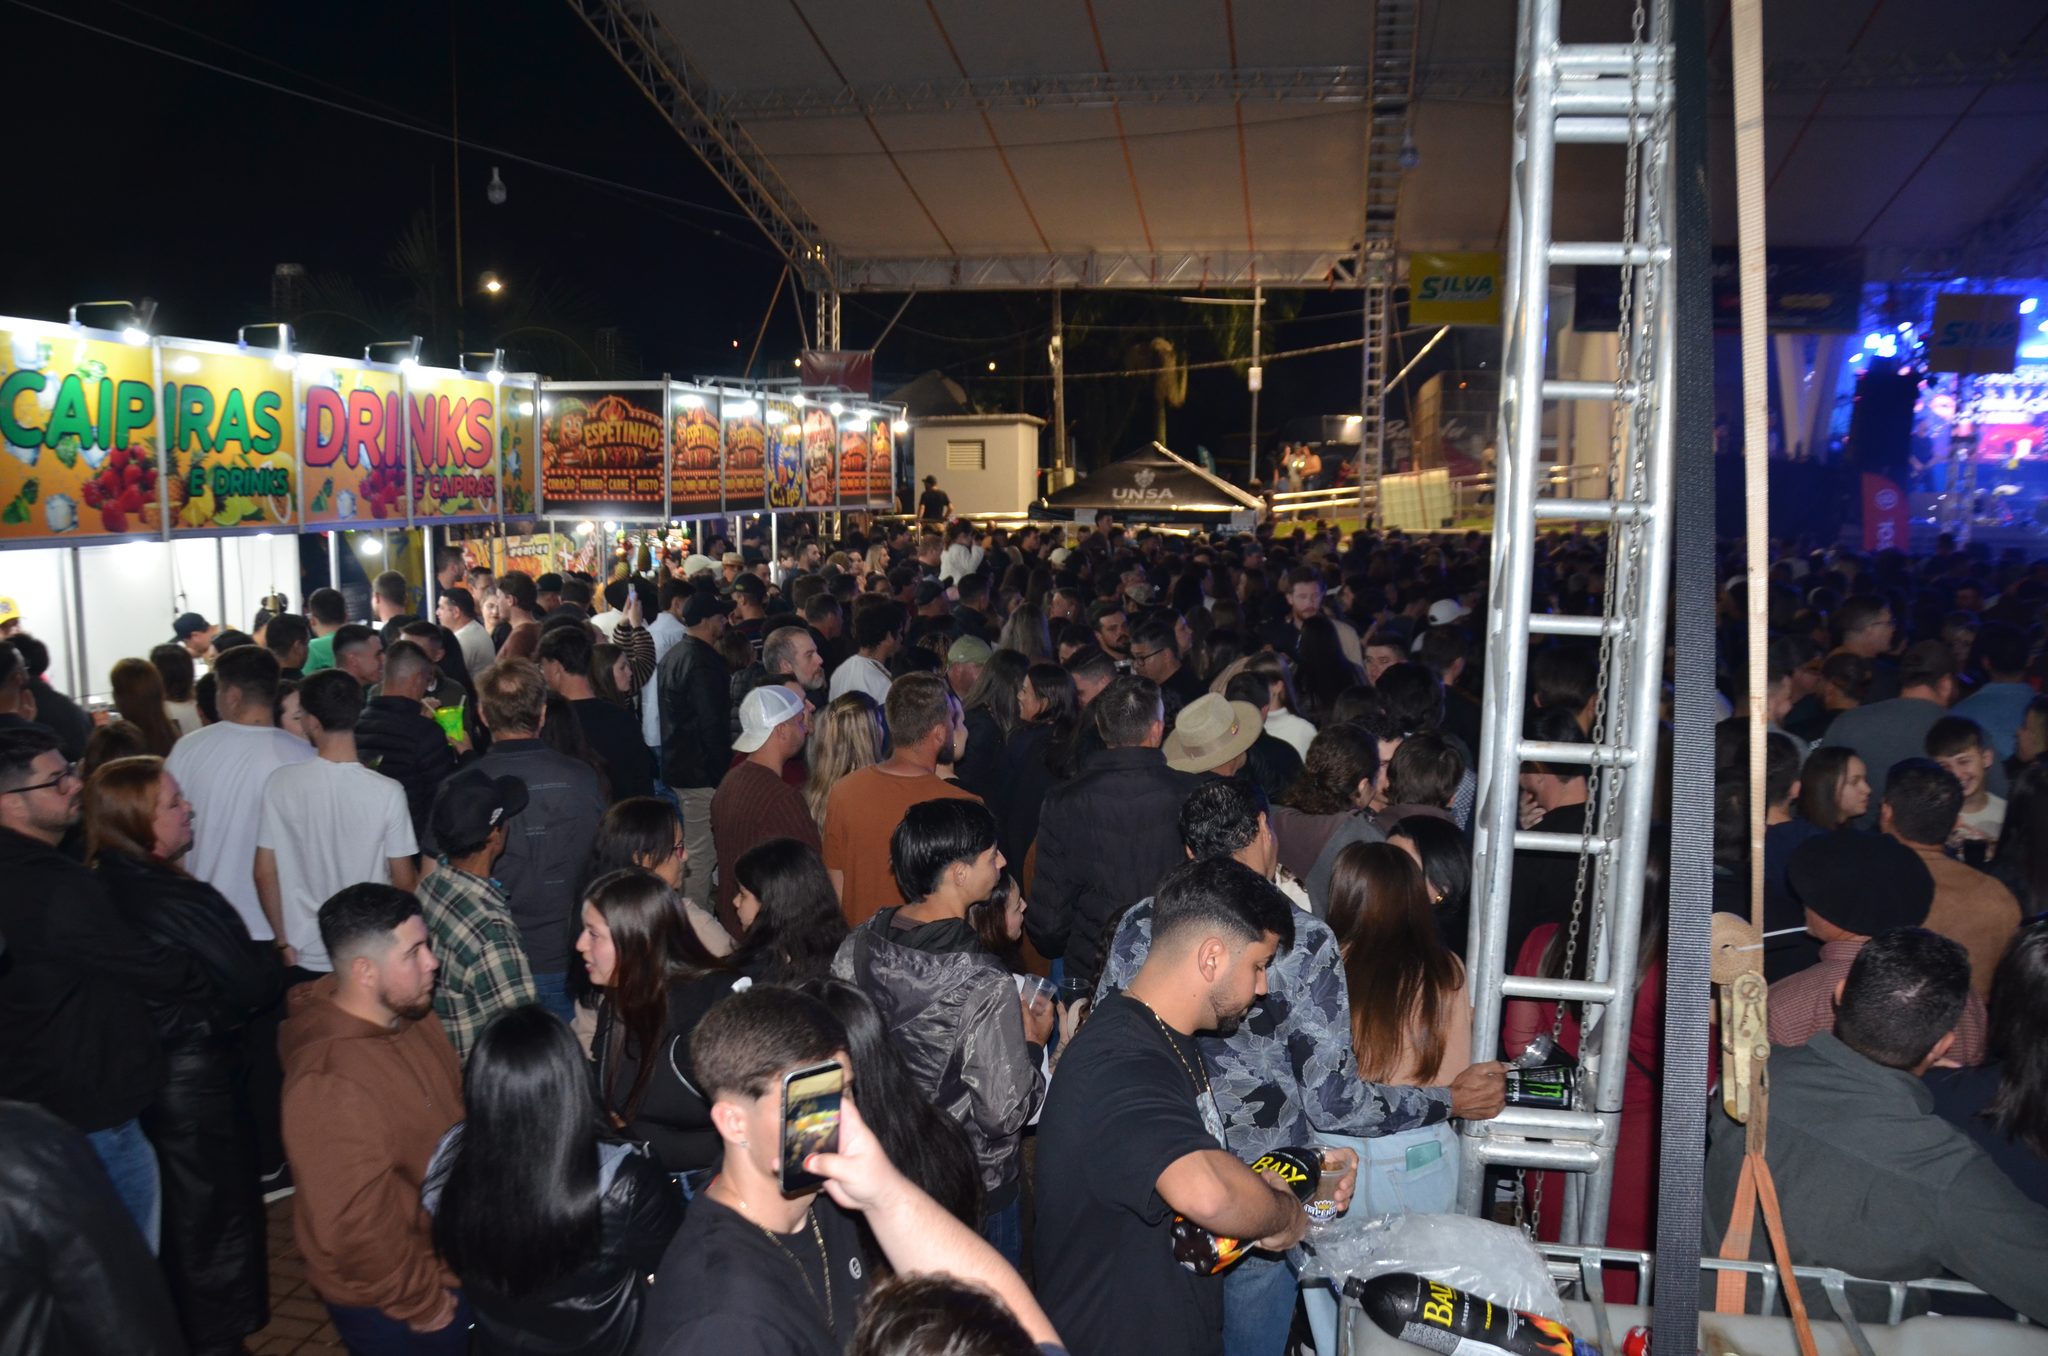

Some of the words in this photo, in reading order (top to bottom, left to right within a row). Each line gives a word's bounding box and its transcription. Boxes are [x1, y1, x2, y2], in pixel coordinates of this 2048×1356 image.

[1418, 276, 1495, 299] SILVA
[1, 370, 282, 455] CAIPIRAS
[303, 386, 495, 469] DRINKS
[583, 420, 660, 450] ESPETINHO
[189, 468, 206, 496] E
[213, 467, 289, 496] DRINKS
[413, 475, 425, 497] E
[429, 474, 495, 499] CAIPIRAS
[1111, 487, 1174, 499] UNSA
[1252, 1156, 1308, 1183] BALY
[1423, 1280, 1454, 1328] BAL
